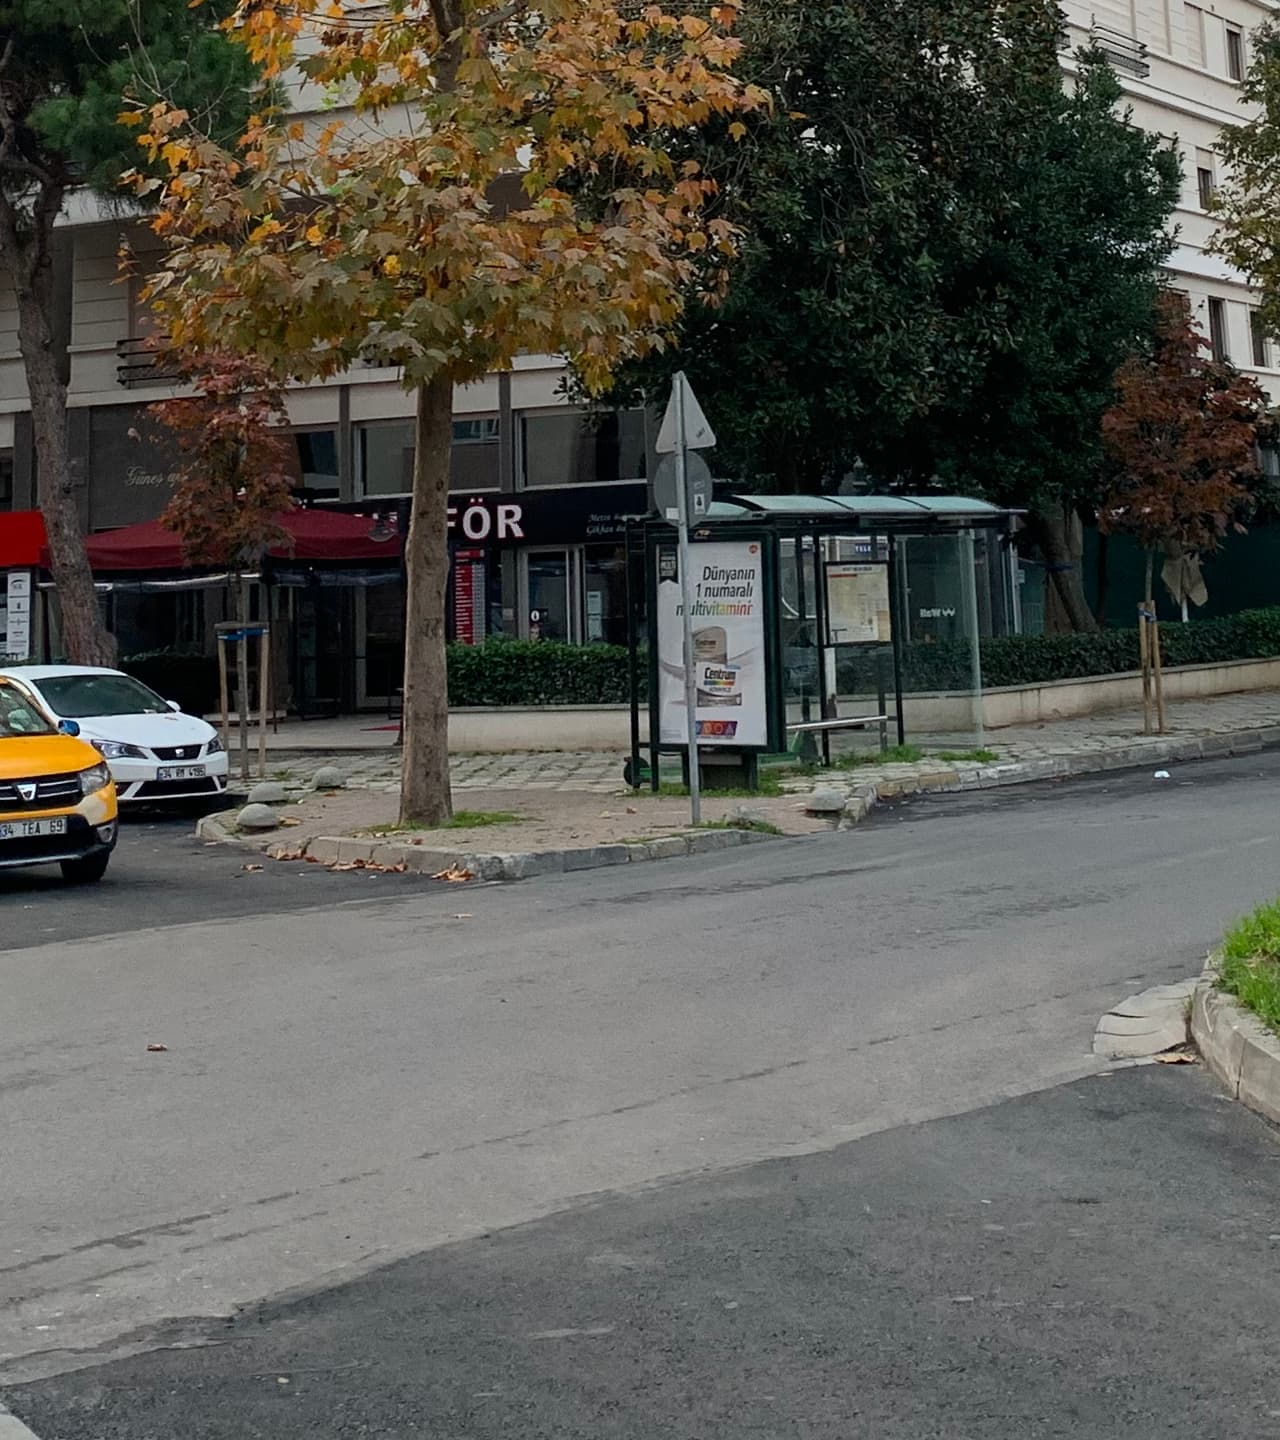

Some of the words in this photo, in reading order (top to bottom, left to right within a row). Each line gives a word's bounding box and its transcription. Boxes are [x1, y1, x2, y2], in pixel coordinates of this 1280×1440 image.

[703, 565, 755, 584] Dünyanın
[696, 583, 701, 597] 1
[704, 582, 753, 598] numaralı
[704, 667, 736, 680] Centrum
[1, 823, 14, 836] 34
[22, 820, 41, 835] TEA
[49, 818, 63, 833] 69
